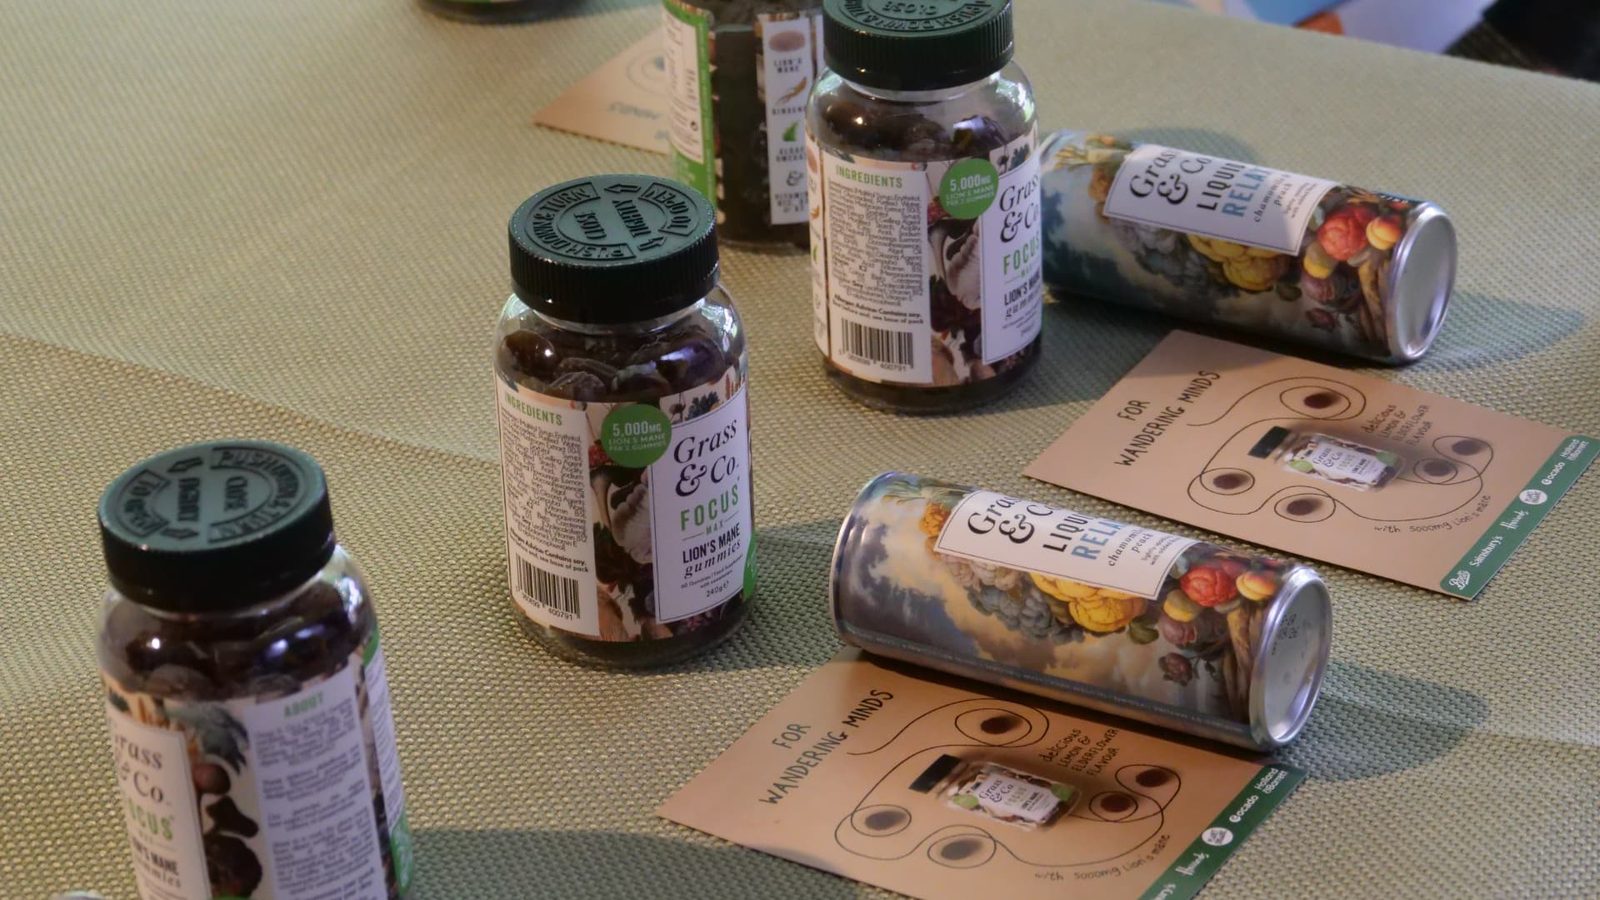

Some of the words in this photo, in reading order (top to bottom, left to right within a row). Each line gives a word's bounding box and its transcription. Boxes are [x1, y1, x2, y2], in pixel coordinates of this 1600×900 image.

[836, 164, 903, 189] INGREDIENTS
[1157, 174, 1188, 205] &
[546, 187, 591, 213] TURN
[573, 210, 607, 240] CLOSE
[612, 199, 652, 238] TIGHTLY
[1000, 211, 1023, 243] &
[1004, 282, 1027, 305] LION'S
[505, 391, 562, 426] INGREDIENTS
[1113, 406, 1185, 466] WANDERING
[1177, 370, 1221, 403] MINDS
[1117, 400, 1151, 421] FOR
[674, 420, 737, 464] Grass
[675, 463, 708, 497] &
[1547, 462, 1565, 479] ocado
[680, 483, 739, 531] FOCUS
[705, 520, 724, 535] MAX
[999, 514, 1035, 544] &
[1043, 513, 1093, 552] LIQUI
[1071, 520, 1127, 559] RELA
[1374, 525, 1400, 533] with
[1409, 521, 1452, 532] 5000mg
[682, 540, 716, 564] LION'S
[718, 522, 741, 548] MANE
[1131, 532, 1154, 553] peach
[1469, 536, 1503, 567] Sainsbury's
[684, 542, 741, 580] gummies
[758, 731, 848, 804] WANDERING
[842, 689, 894, 728] MINDS
[772, 723, 811, 749] FOR
[1071, 729, 1118, 772] ELDERFLOWER
[114, 734, 162, 770] rass
[1058, 745, 1083, 768] LEMON
[1077, 735, 1091, 745] &
[1086, 748, 1121, 776] FLAVOUR
[979, 779, 1003, 799] Grass
[1254, 767, 1279, 790] Holland
[989, 792, 1003, 803] &
[1236, 795, 1259, 816] ocado
[1035, 871, 1064, 881] with
[1073, 866, 1121, 881] 5000mg
